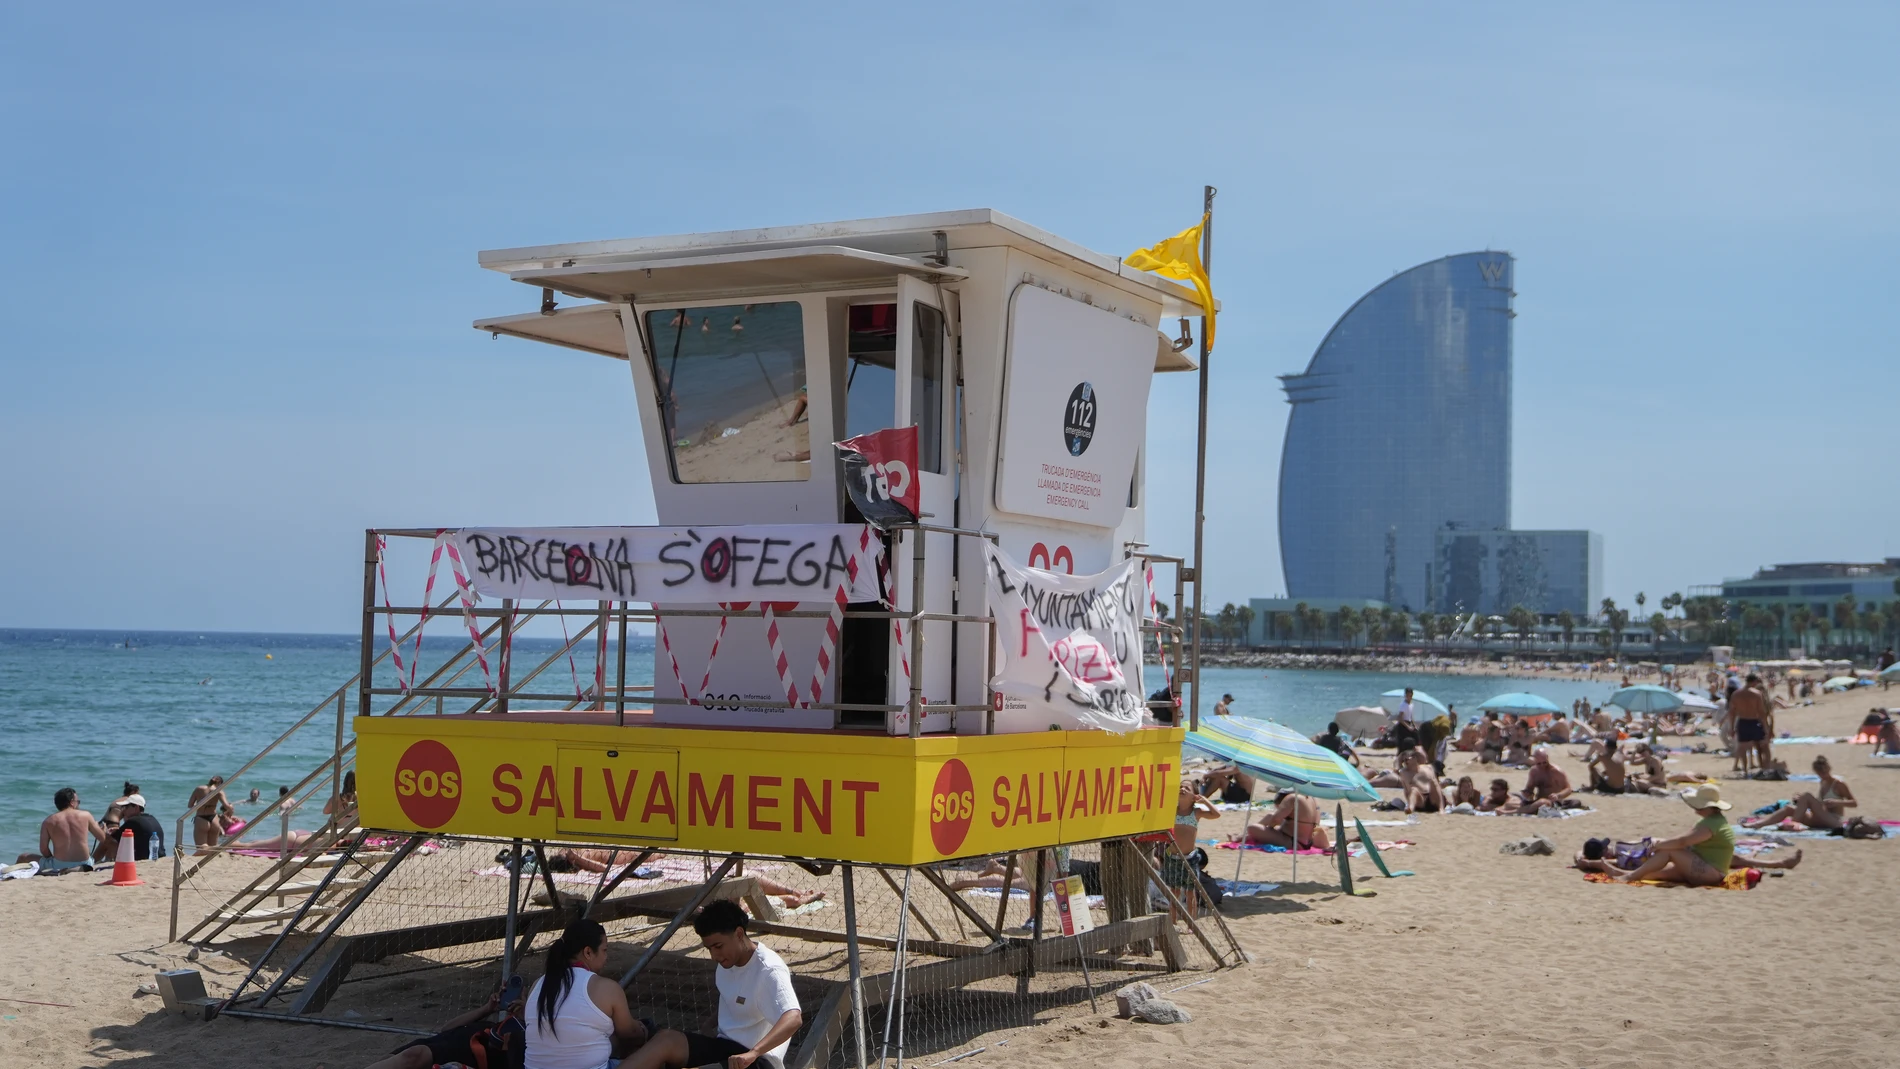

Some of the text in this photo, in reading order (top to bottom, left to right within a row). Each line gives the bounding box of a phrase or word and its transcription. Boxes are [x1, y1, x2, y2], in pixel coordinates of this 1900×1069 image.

[1477, 260, 1506, 282] W
[1071, 399, 1093, 428] 112
[1042, 464, 1064, 477] TRUCADA
[1038, 478, 1101, 498] LLAMADA DE EMERGENCIA
[1047, 494, 1089, 510] EMERGENCY CALL
[398, 763, 880, 837] SOS SALVAMENT
[931, 764, 1171, 828] SOS SALVAMENT
